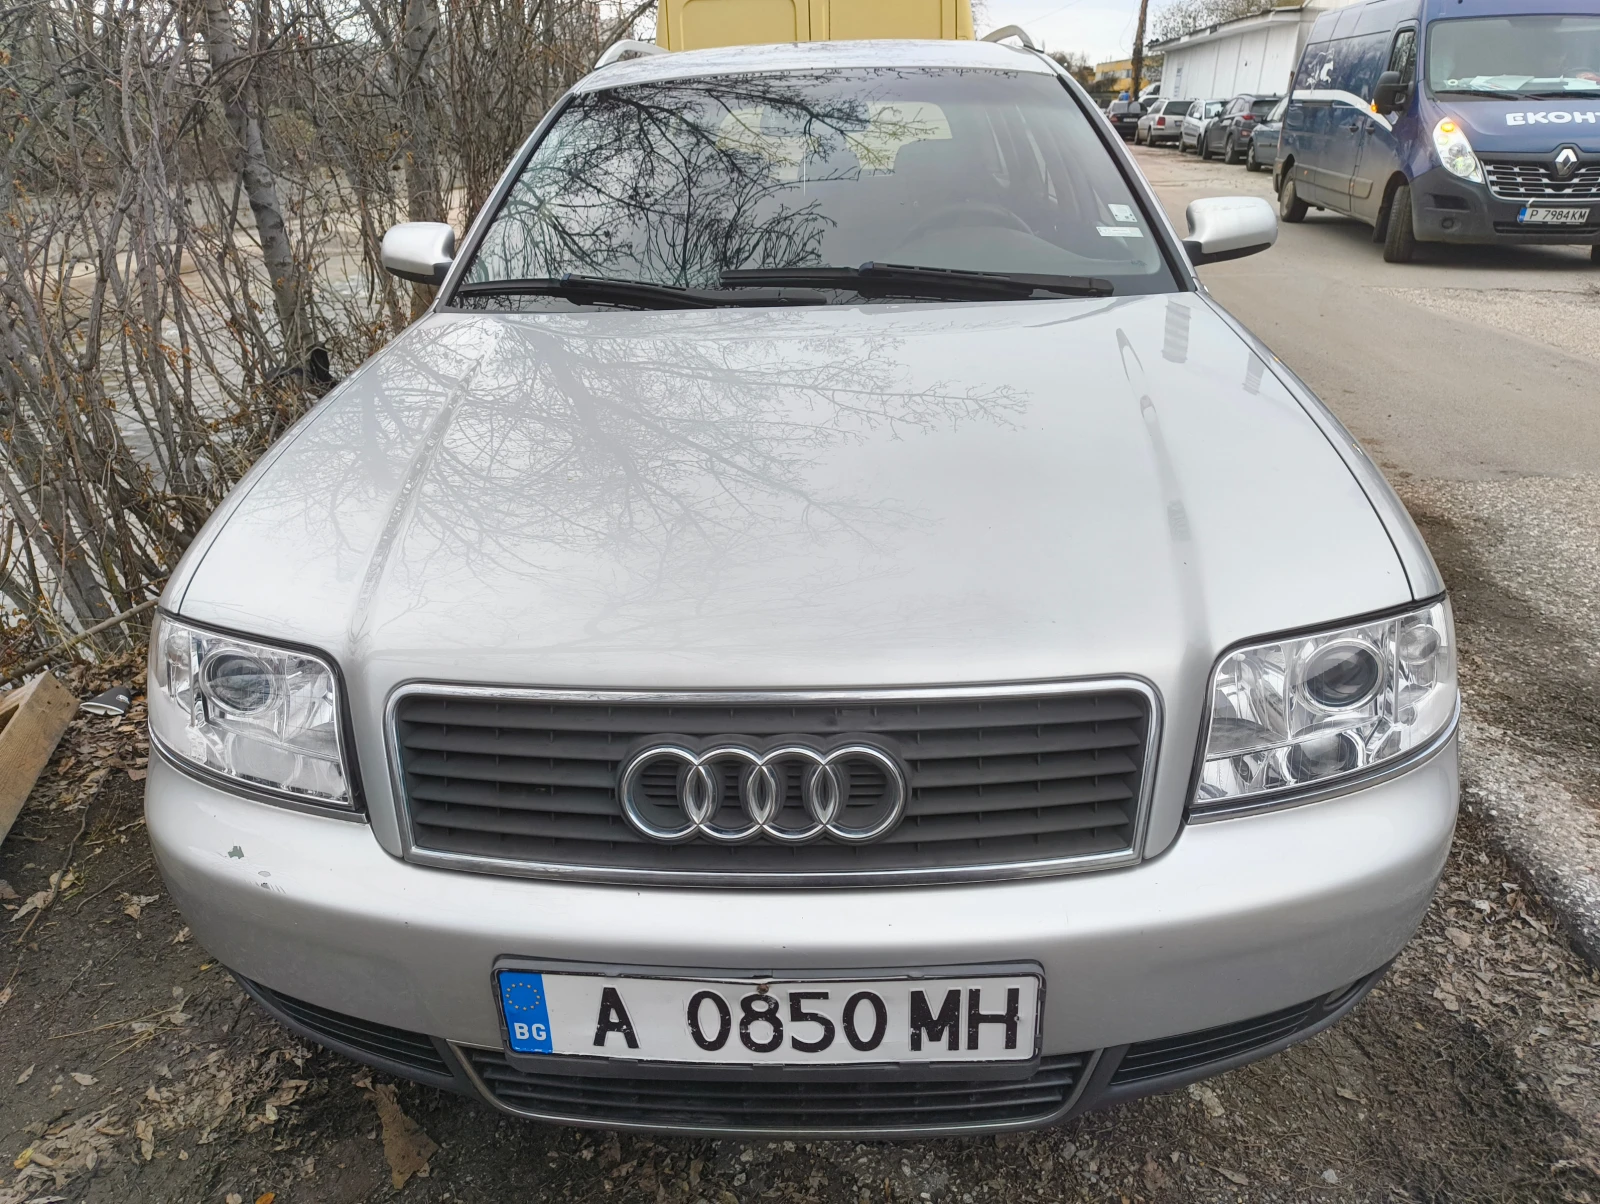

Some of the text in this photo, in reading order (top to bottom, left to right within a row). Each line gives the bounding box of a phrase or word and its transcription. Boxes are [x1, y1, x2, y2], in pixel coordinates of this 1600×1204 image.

[513, 1022, 547, 1041] BG
[593, 986, 1020, 1053] A 0850 MH
